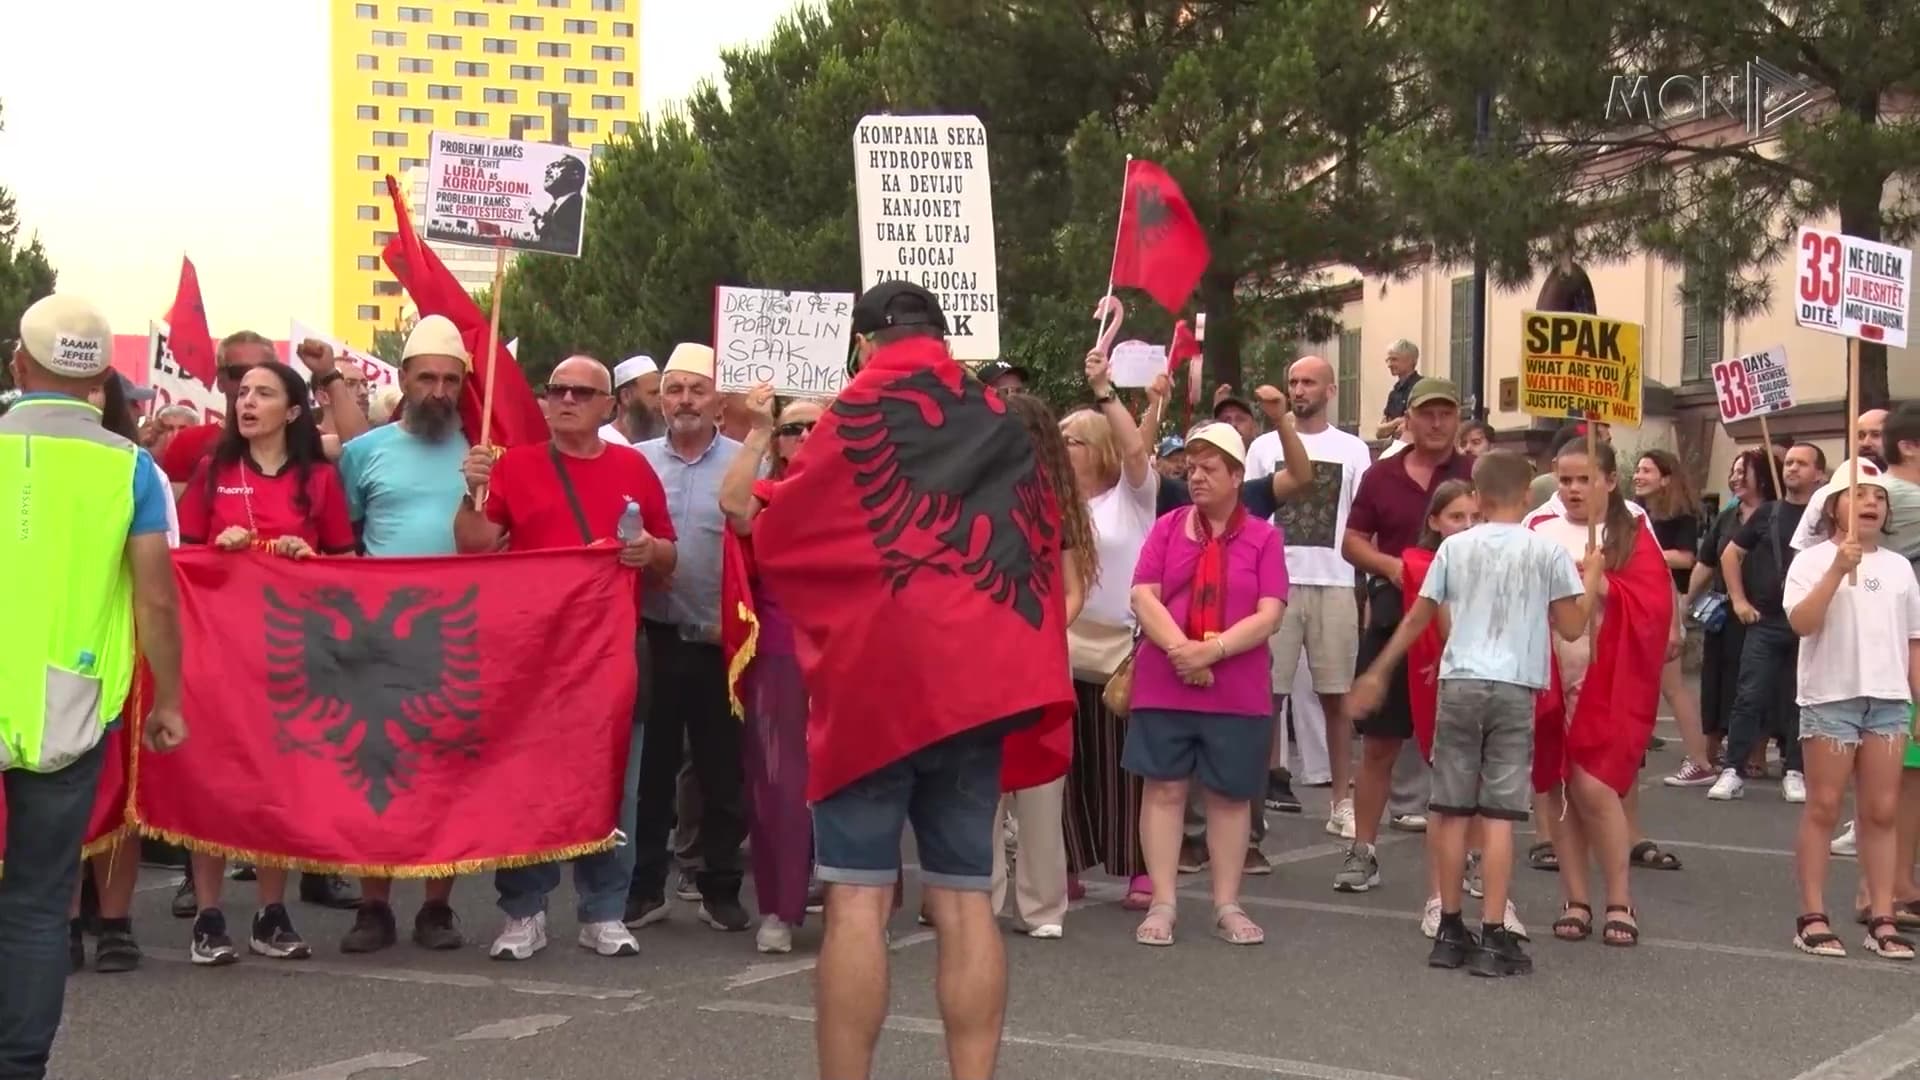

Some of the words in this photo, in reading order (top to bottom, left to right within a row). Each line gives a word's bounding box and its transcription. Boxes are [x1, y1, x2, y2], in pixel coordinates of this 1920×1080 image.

[860, 126, 938, 145] KOMPANIA
[947, 127, 985, 146] SEKA
[440, 140, 485, 156] PROBLEMI
[493, 145, 524, 158] RAMËS
[461, 158, 475, 166] NUK
[478, 158, 500, 169] ËSHTË
[870, 150, 973, 169] HYDROPOWER
[445, 164, 485, 179] LUBIA
[489, 172, 498, 180] AS
[443, 176, 532, 195] KORRUPSIONI.
[882, 174, 901, 192] KA
[910, 175, 963, 193] DEVIJU
[436, 191, 477, 204] PROBLEMI
[883, 198, 961, 217] KANJONET
[455, 204, 524, 220] PROTESTUESIT.
[877, 222, 916, 242] URAK
[926, 224, 970, 243] LUFAJ
[898, 247, 954, 265] GJOCAJ
[1849, 246, 1863, 270] NE
[1800, 232, 1842, 306] 33
[921, 271, 977, 290] GJOCAJ
[1846, 276, 1860, 299] JU
[728, 314, 840, 338] POPULLIN
[61, 338, 98, 349] RAAMA
[726, 339, 809, 362] SPAK
[1527, 359, 1563, 374] WHAT
[1568, 361, 1590, 378] ARE
[1594, 365, 1619, 381] YOU
[1742, 352, 1774, 373] DAYS.
[1526, 374, 1584, 392] WAITING
[1588, 381, 1620, 398] FOR?
[1714, 360, 1752, 418] 33
[1526, 393, 1575, 410] JUSTICE
[1577, 398, 1609, 415] CAN'T
[1612, 402, 1638, 421] WAIT.
[21, 481, 32, 515] RYSEL
[20, 519, 29, 541] VAN
